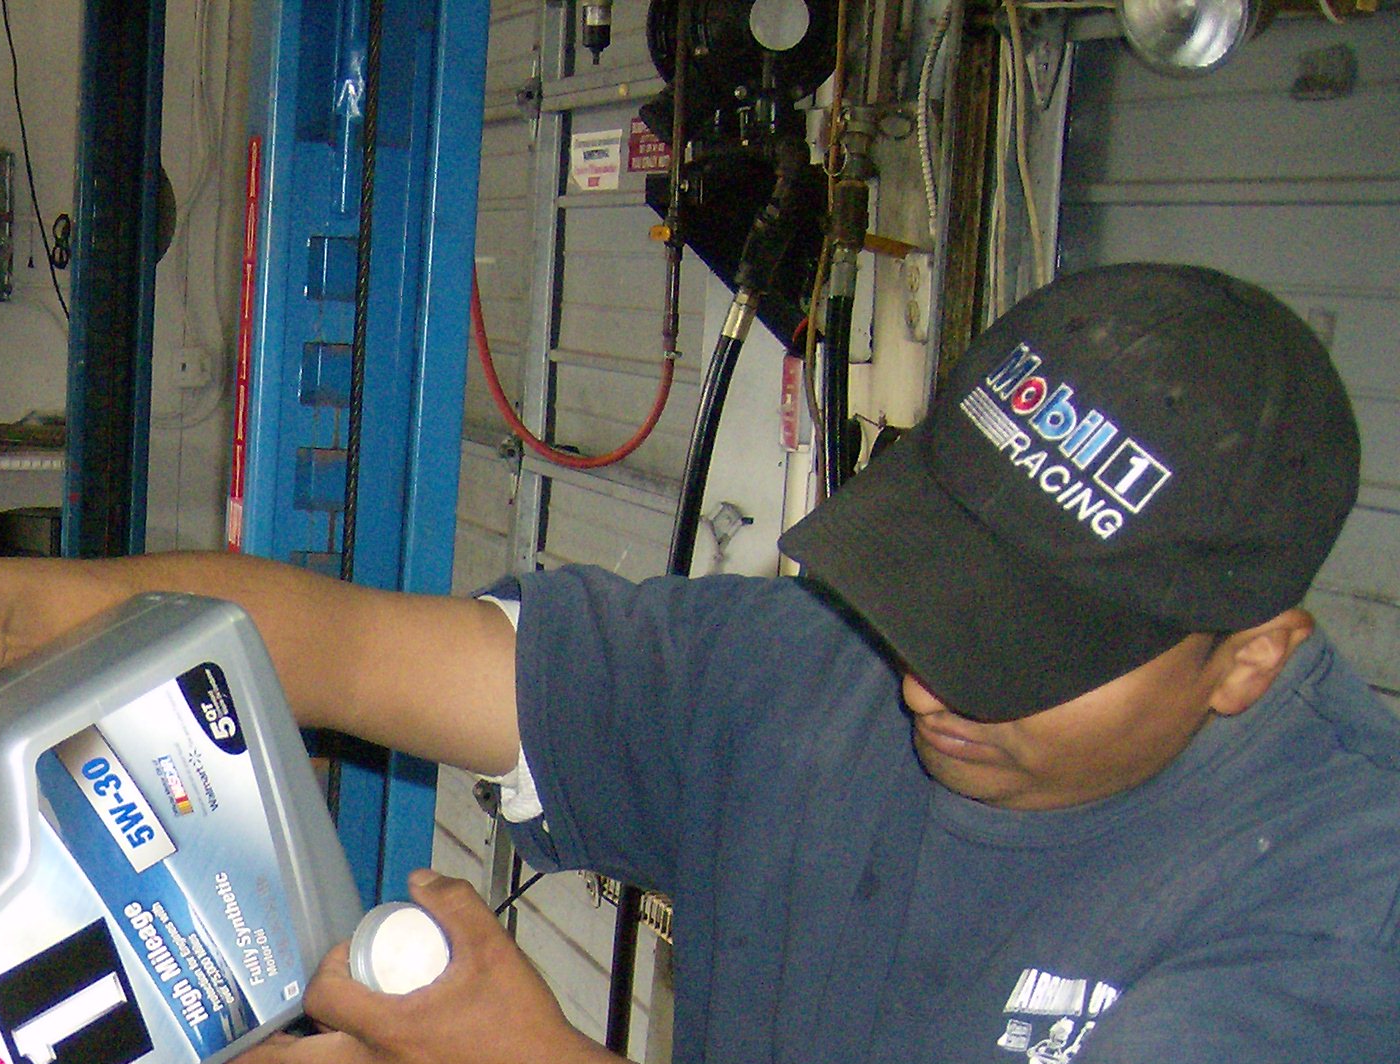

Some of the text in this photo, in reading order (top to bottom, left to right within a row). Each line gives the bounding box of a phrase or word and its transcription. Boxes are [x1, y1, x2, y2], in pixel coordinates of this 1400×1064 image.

[986, 342, 1118, 470] Mobil
[1009, 431, 1123, 539] RACING
[201, 702, 217, 722] QT
[209, 716, 236, 740] 5
[81, 757, 155, 849] 5W-30
[196, 765, 219, 812] Walmart
[151, 900, 225, 1013] Protection for Engines with
[215, 871, 265, 987] Fully Synthetic
[253, 927, 268, 945] Oil
[260, 944, 278, 977] Motor
[123, 902, 209, 1028] High Mileage
[200, 956, 228, 988] 75,000
